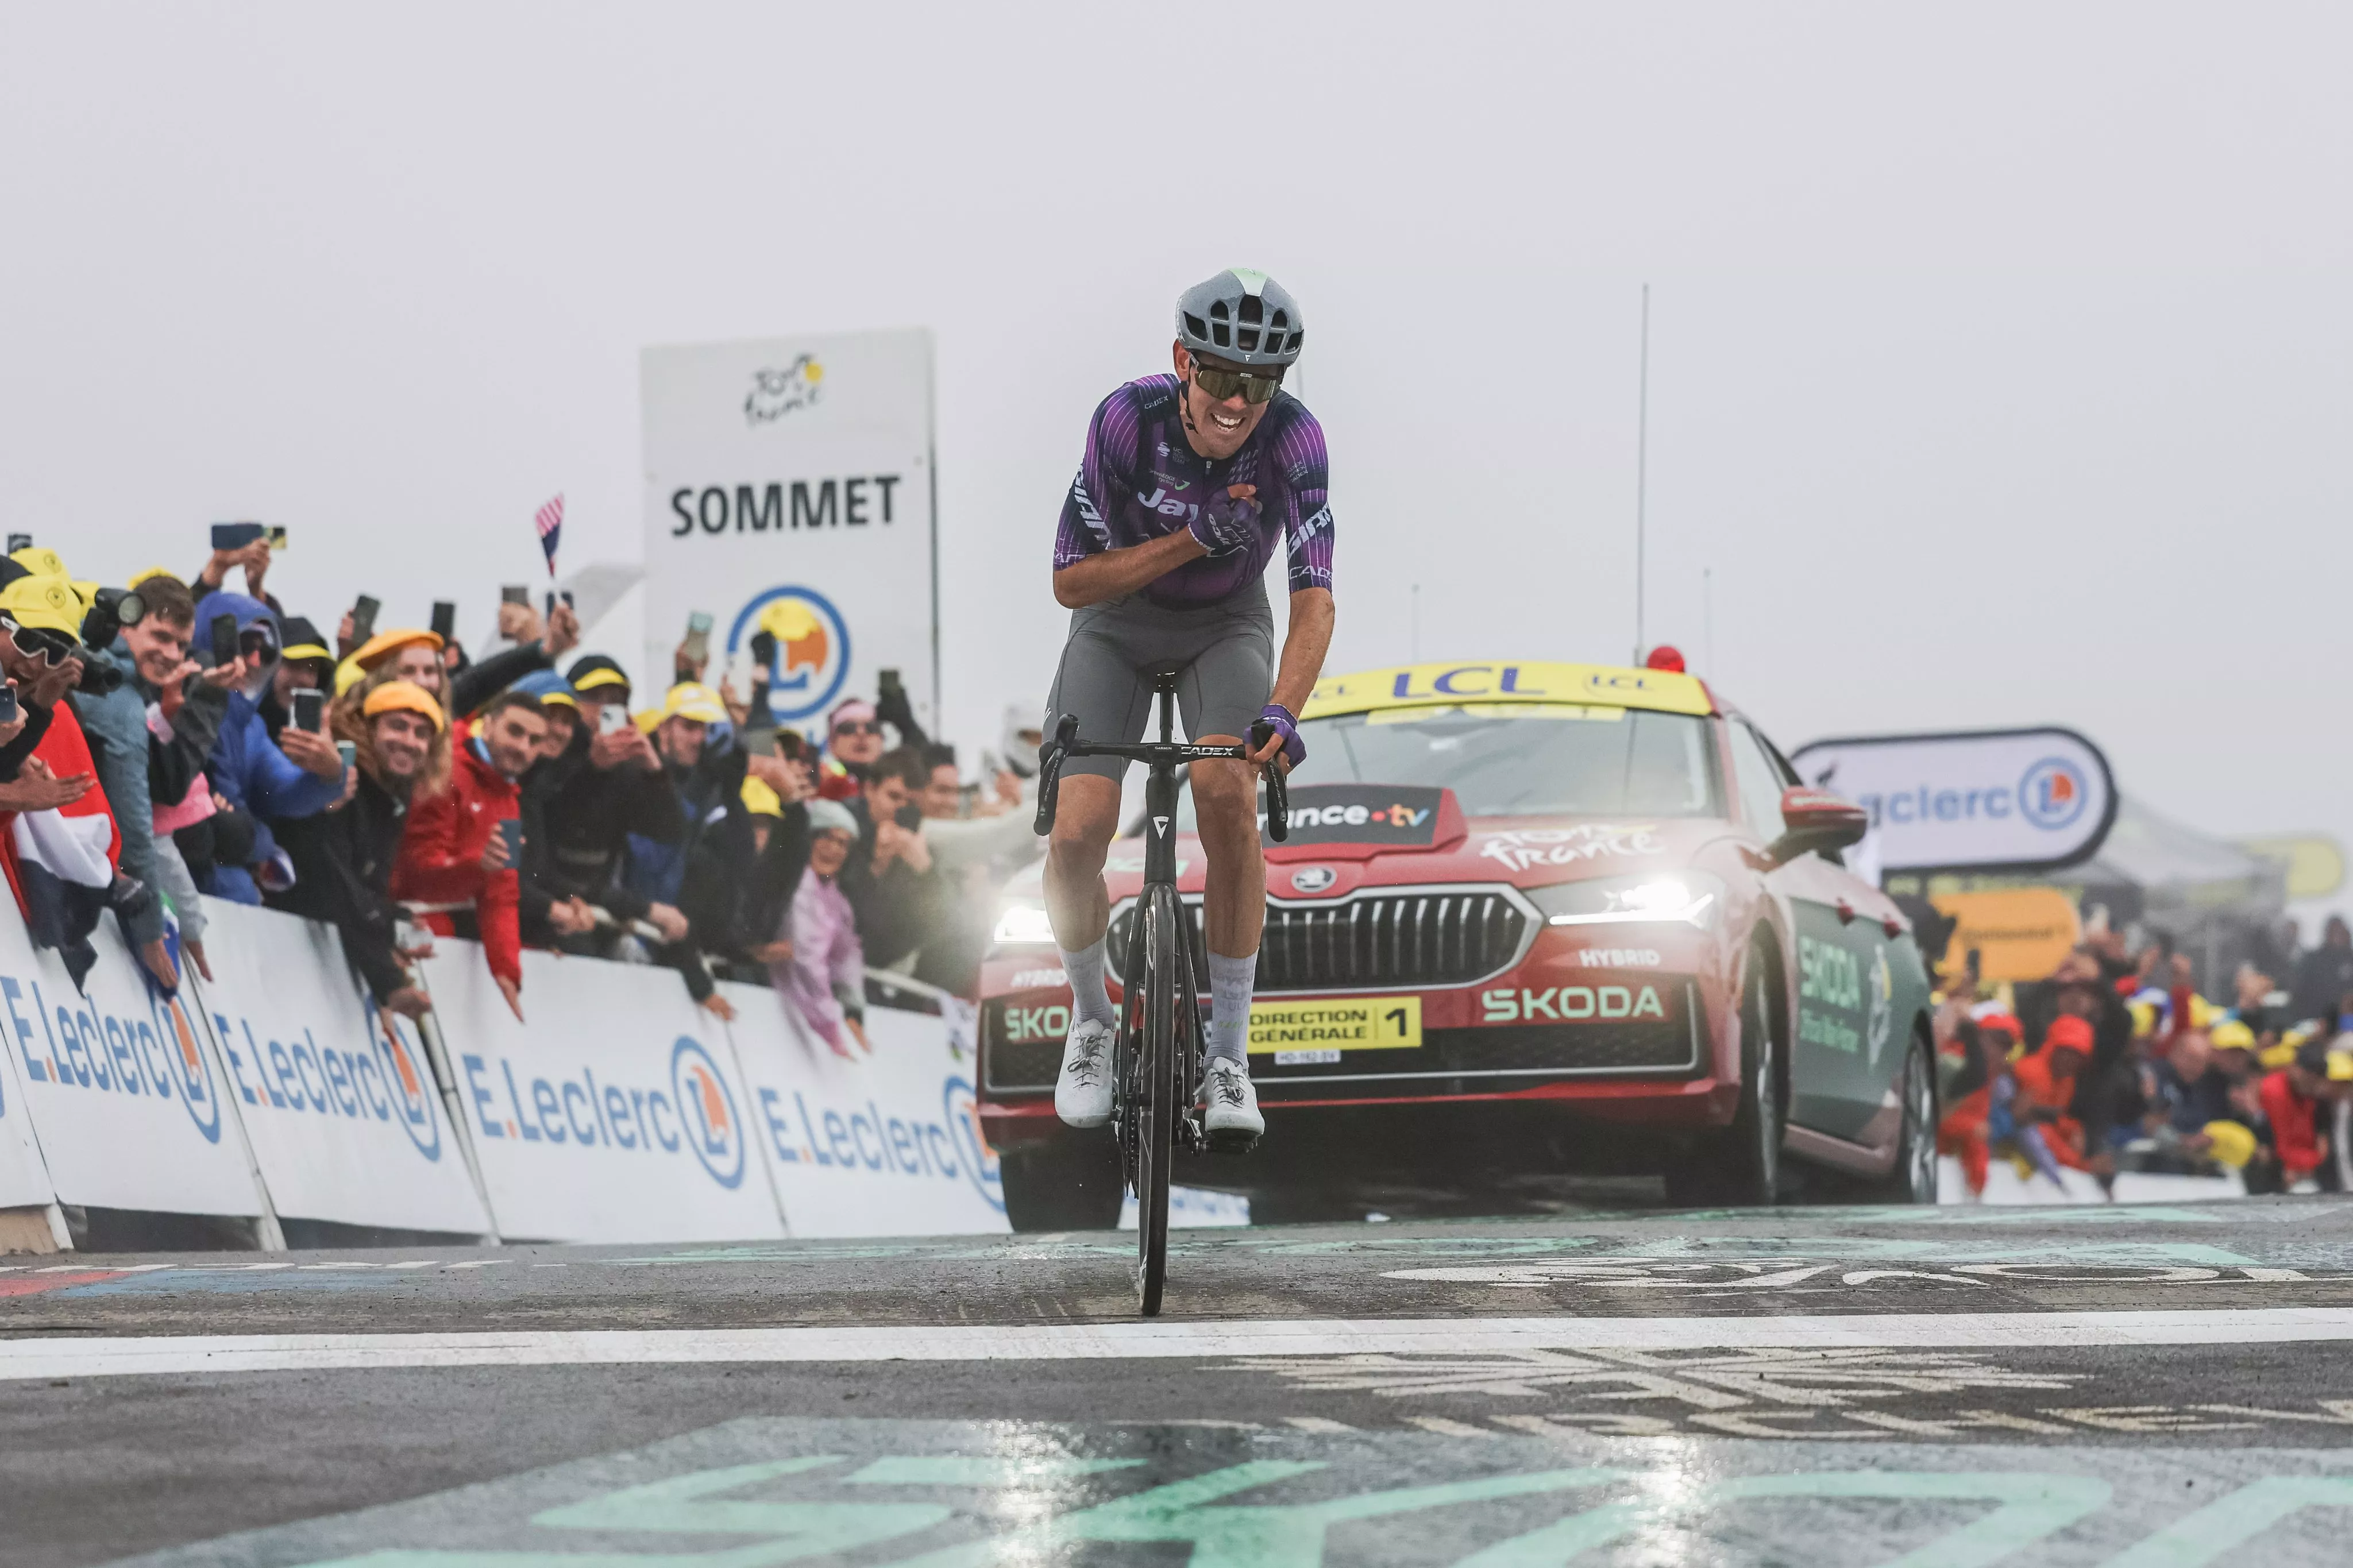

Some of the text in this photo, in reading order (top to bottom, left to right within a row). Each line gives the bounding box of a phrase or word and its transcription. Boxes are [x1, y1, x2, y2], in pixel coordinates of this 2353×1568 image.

[1144, 395, 1168, 409] CADEX
[671, 476, 901, 537] SOMMET
[1137, 488, 1199, 522] Jay
[1290, 565, 1333, 582] CAD
[1312, 683, 1356, 700] CL
[1392, 667, 1546, 699] LCL
[1591, 673, 1654, 692] LCL
[1181, 746, 1234, 756] CADEX
[1859, 783, 2012, 828] clerc
[1579, 949, 1660, 967] HYBRID
[1249, 1007, 1367, 1026] DIRECTION
[1384, 1008, 1407, 1037] 1
[0, 975, 172, 1100] E.Leclerc
[213, 1013, 391, 1122] E.Leclerc
[462, 1053, 680, 1153] E.Leclerc
[759, 1087, 958, 1179] E.Leclerc
